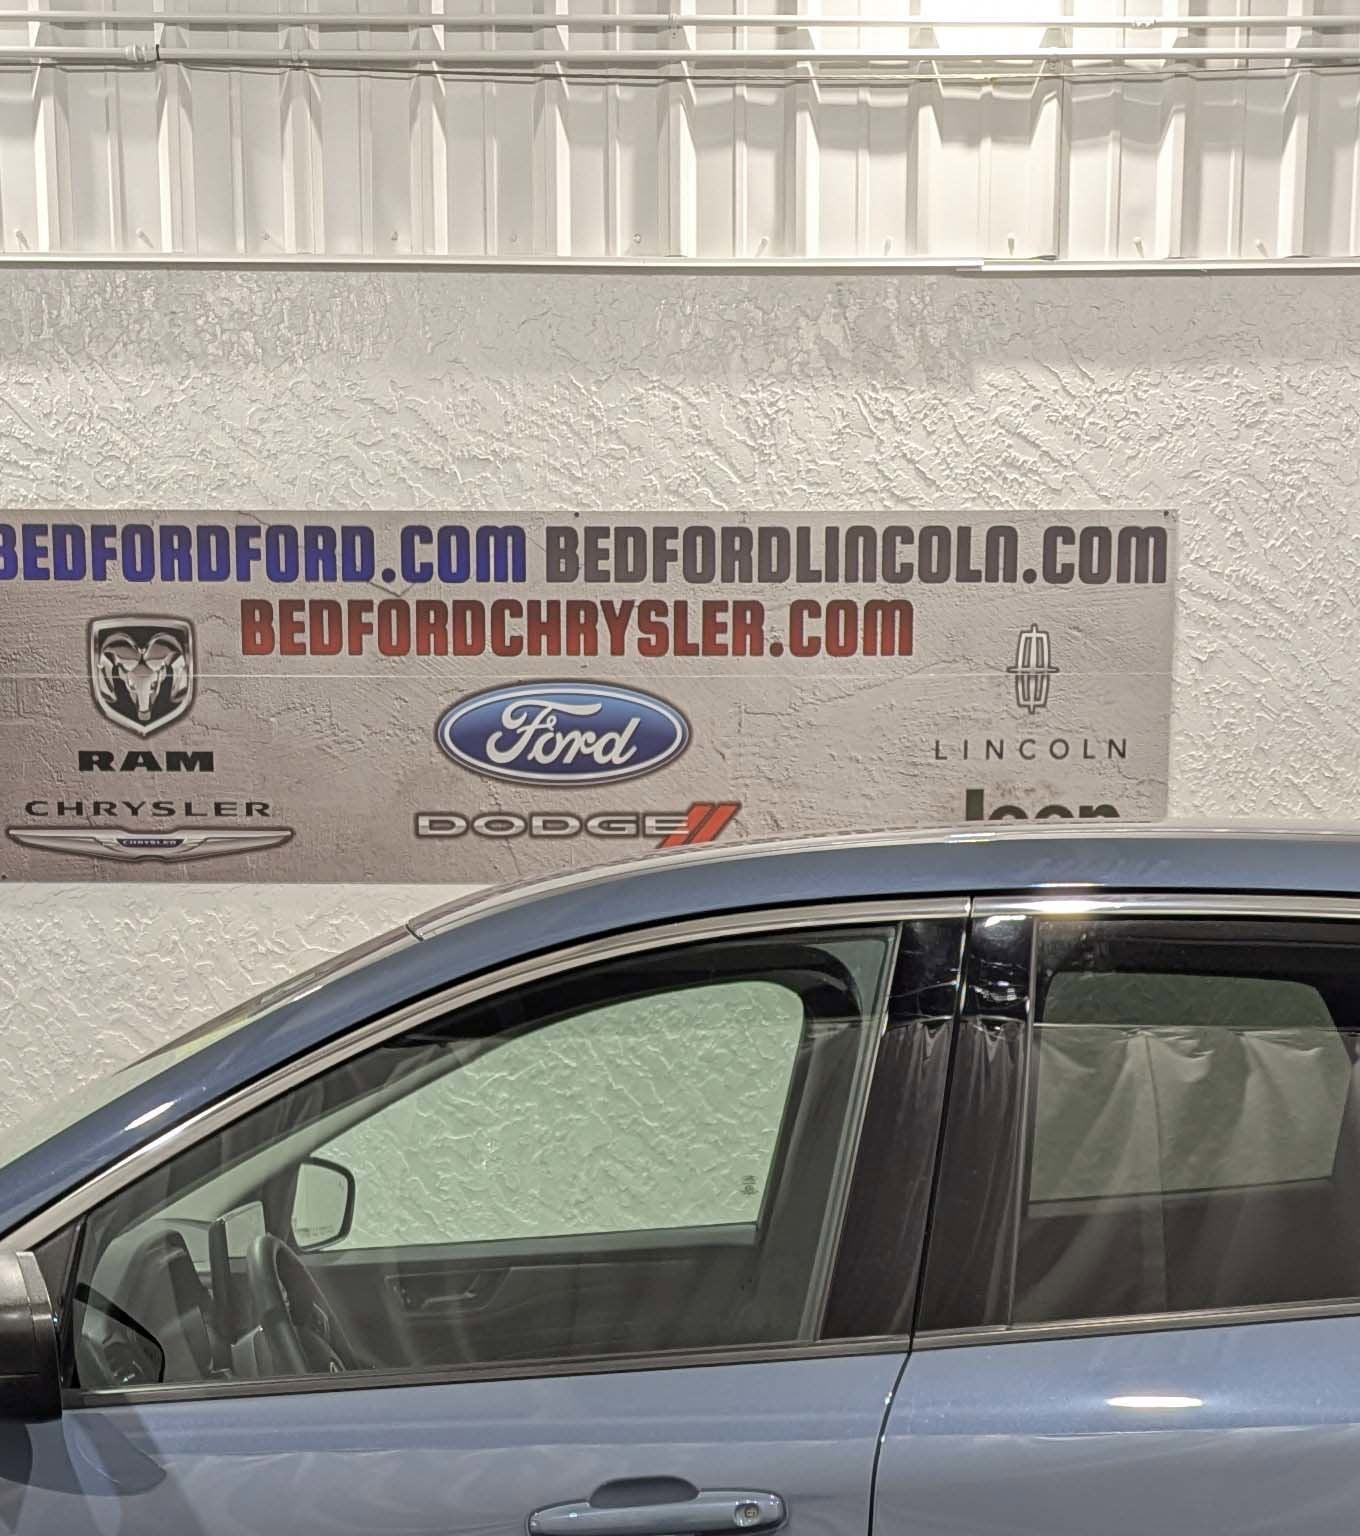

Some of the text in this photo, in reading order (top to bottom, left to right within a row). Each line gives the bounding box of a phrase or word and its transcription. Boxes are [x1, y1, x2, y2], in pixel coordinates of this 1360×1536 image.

[546, 525, 1168, 584] BEDFORDLINCOLN.COM
[241, 598, 914, 658] BEDFORDCHRYSLER.COM
[485, 699, 641, 765] Ford
[78, 750, 215, 773] RAM
[934, 737, 1127, 761] LINCOLN
[25, 800, 271, 818] CHRYSLER
[414, 812, 691, 839] DODGE
